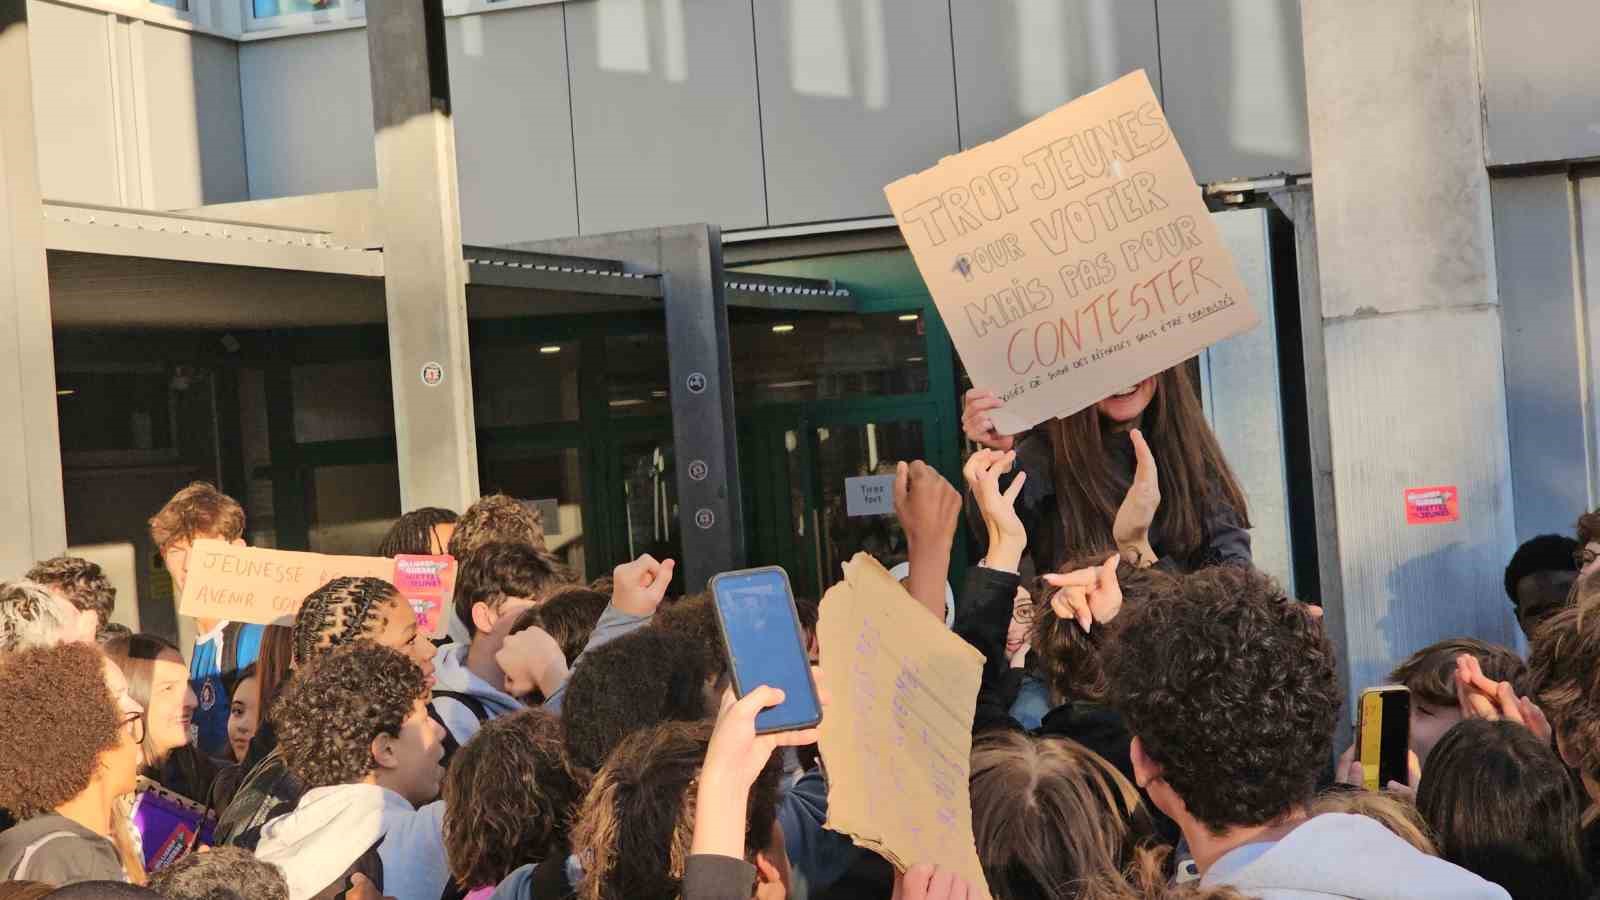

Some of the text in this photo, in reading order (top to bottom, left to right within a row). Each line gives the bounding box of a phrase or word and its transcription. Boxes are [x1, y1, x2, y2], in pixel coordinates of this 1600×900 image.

[903, 101, 1171, 246] TROP JEUNES
[953, 171, 1168, 281] POUR VOTER
[1058, 252, 1117, 298] PAS
[1120, 215, 1203, 272] POUR
[1007, 256, 1222, 375] CONTESTER
[196, 585, 255, 608] AVENIR
[202, 552, 304, 583] JEUNESSE
